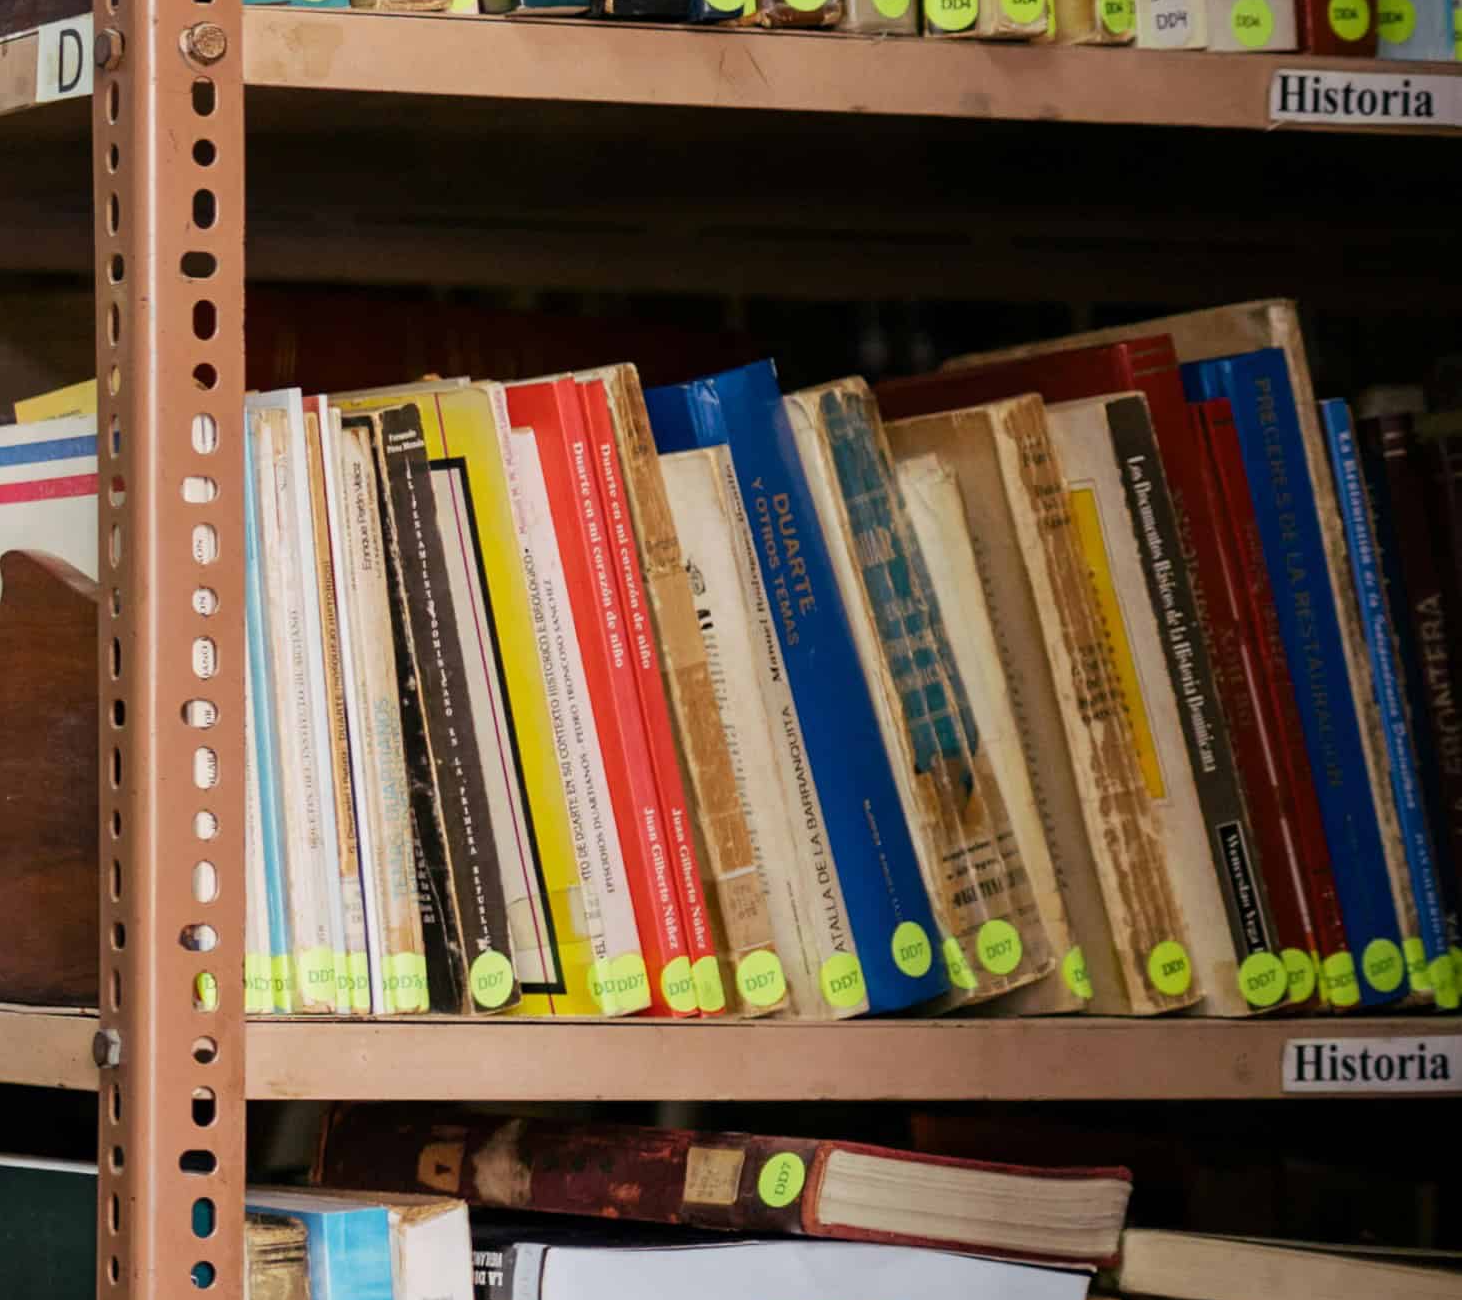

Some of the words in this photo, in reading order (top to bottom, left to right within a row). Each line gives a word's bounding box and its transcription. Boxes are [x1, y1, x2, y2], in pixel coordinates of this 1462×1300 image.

[58, 29, 83, 93] D
[1277, 73, 1435, 120] Historia
[573, 441, 591, 496] Duarte
[599, 443, 618, 498] Duarte
[751, 477, 763, 488] Y
[580, 499, 593, 519] en
[612, 500, 623, 520] en
[587, 524, 603, 543] mi
[615, 524, 627, 544] mi
[755, 493, 782, 568] OTROS
[773, 491, 815, 615] DUARTE
[592, 546, 613, 607] corazón
[620, 547, 640, 609] corazón
[605, 612, 617, 629] de
[632, 612, 643, 630] de
[772, 575, 800, 647] TEMAS
[609, 632, 624, 669] niño
[636, 633, 651, 670] niño
[642, 805, 657, 838] Juan
[671, 806, 685, 838] Juan
[647, 840, 669, 903] Gilberto
[676, 840, 697, 903] Gilberto
[662, 906, 679, 951] Núñez
[690, 906, 707, 951] Núñez
[477, 971, 505, 991] DD7
[744, 969, 776, 990] DD7
[1247, 969, 1277, 992] DD7
[1293, 1043, 1450, 1085] Historia
